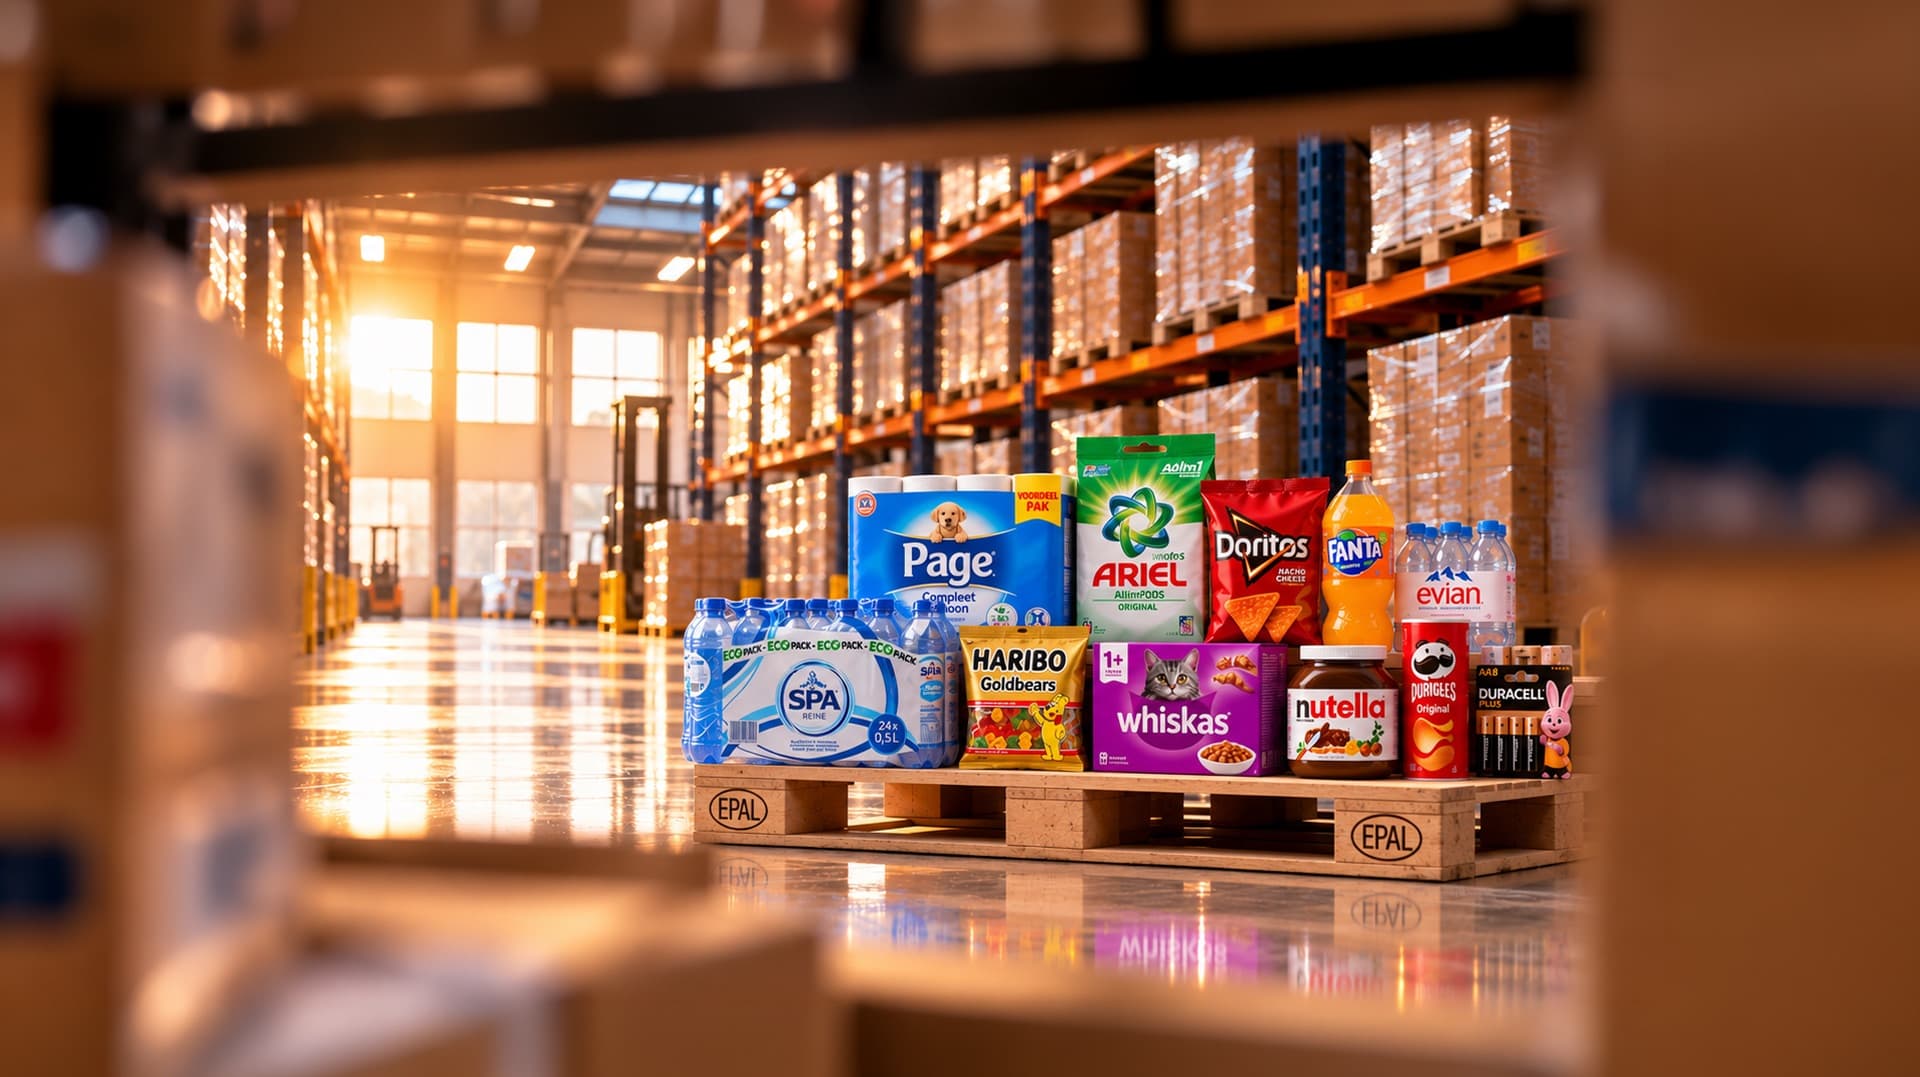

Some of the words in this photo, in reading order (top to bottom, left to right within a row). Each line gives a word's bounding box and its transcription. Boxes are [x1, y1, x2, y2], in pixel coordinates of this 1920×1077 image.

[1018, 491, 1058, 501] VOORDEEL
[1026, 501, 1050, 512] PAK
[1216, 531, 1308, 559] Doritos
[1327, 534, 1384, 564] FANTA
[903, 542, 995, 586] Page
[1092, 562, 1188, 587] ARIEL
[922, 591, 977, 604] Compleet
[1416, 582, 1482, 605] evian
[1118, 603, 1158, 611] ORIGINAL
[723, 647, 743, 662] ECO
[743, 645, 763, 657] PACK
[767, 639, 790, 652] ECO
[790, 641, 812, 651] PACK
[817, 639, 840, 651] ECO
[841, 640, 863, 650] PACK
[868, 641, 894, 655] ECO
[892, 650, 917, 665] PACK
[972, 648, 1067, 673] HARIBO
[1103, 650, 1124, 669] 1+
[981, 676, 1057, 693] Goldbears
[1479, 688, 1545, 700] DURACELL
[789, 689, 841, 711] SPA
[1296, 691, 1386, 720] nutella
[1416, 704, 1450, 716] Original
[802, 713, 827, 721] REINE
[1117, 705, 1229, 736] whiskas
[718, 796, 761, 820] EPAL
[1362, 823, 1413, 852] EPAL
